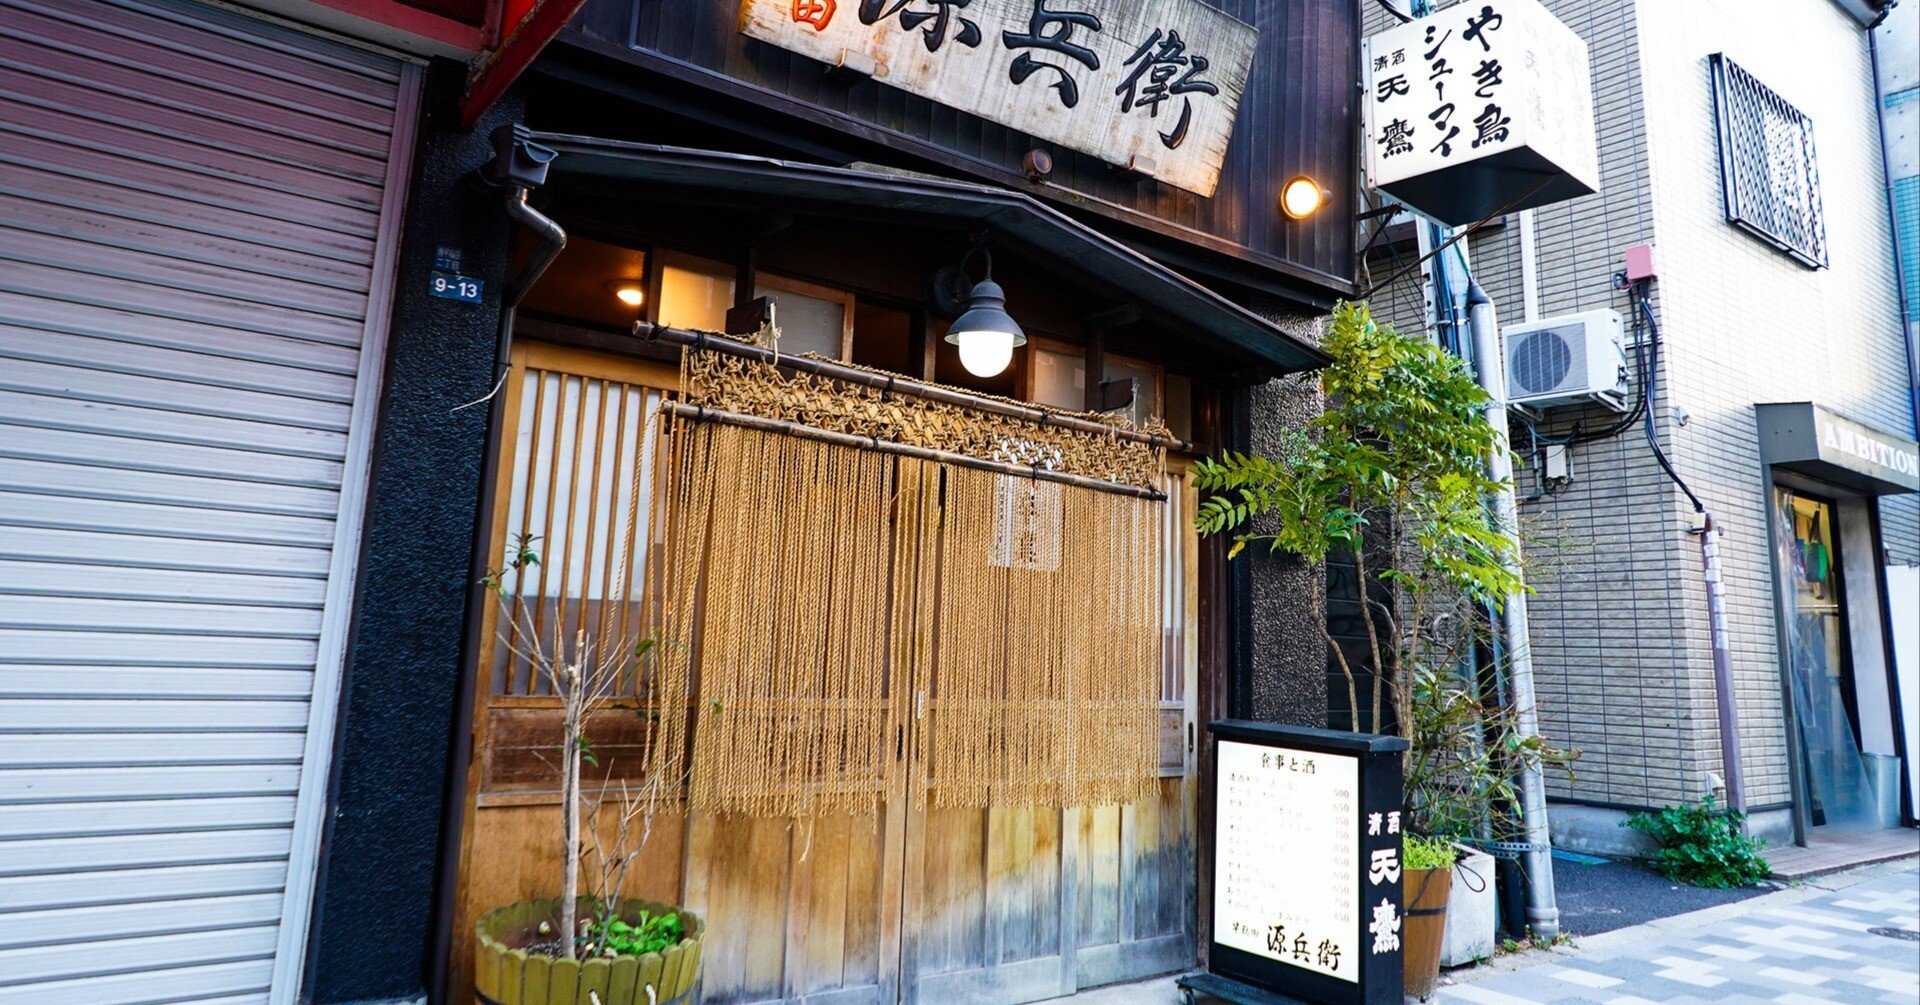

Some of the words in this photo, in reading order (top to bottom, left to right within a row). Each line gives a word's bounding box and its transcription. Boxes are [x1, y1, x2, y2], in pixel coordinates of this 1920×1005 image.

[1373, 48, 1406, 73] 清酒
[1462, 5, 1511, 150] やき鳥
[1423, 25, 1460, 158] シューマイ
[435, 277, 478, 298] 9-13
[1824, 422, 1919, 478] AMBITION
[1260, 751, 1316, 775] 食事と酒
[1368, 810, 1401, 836] 清酒
[1267, 924, 1342, 972] 源兵衛
